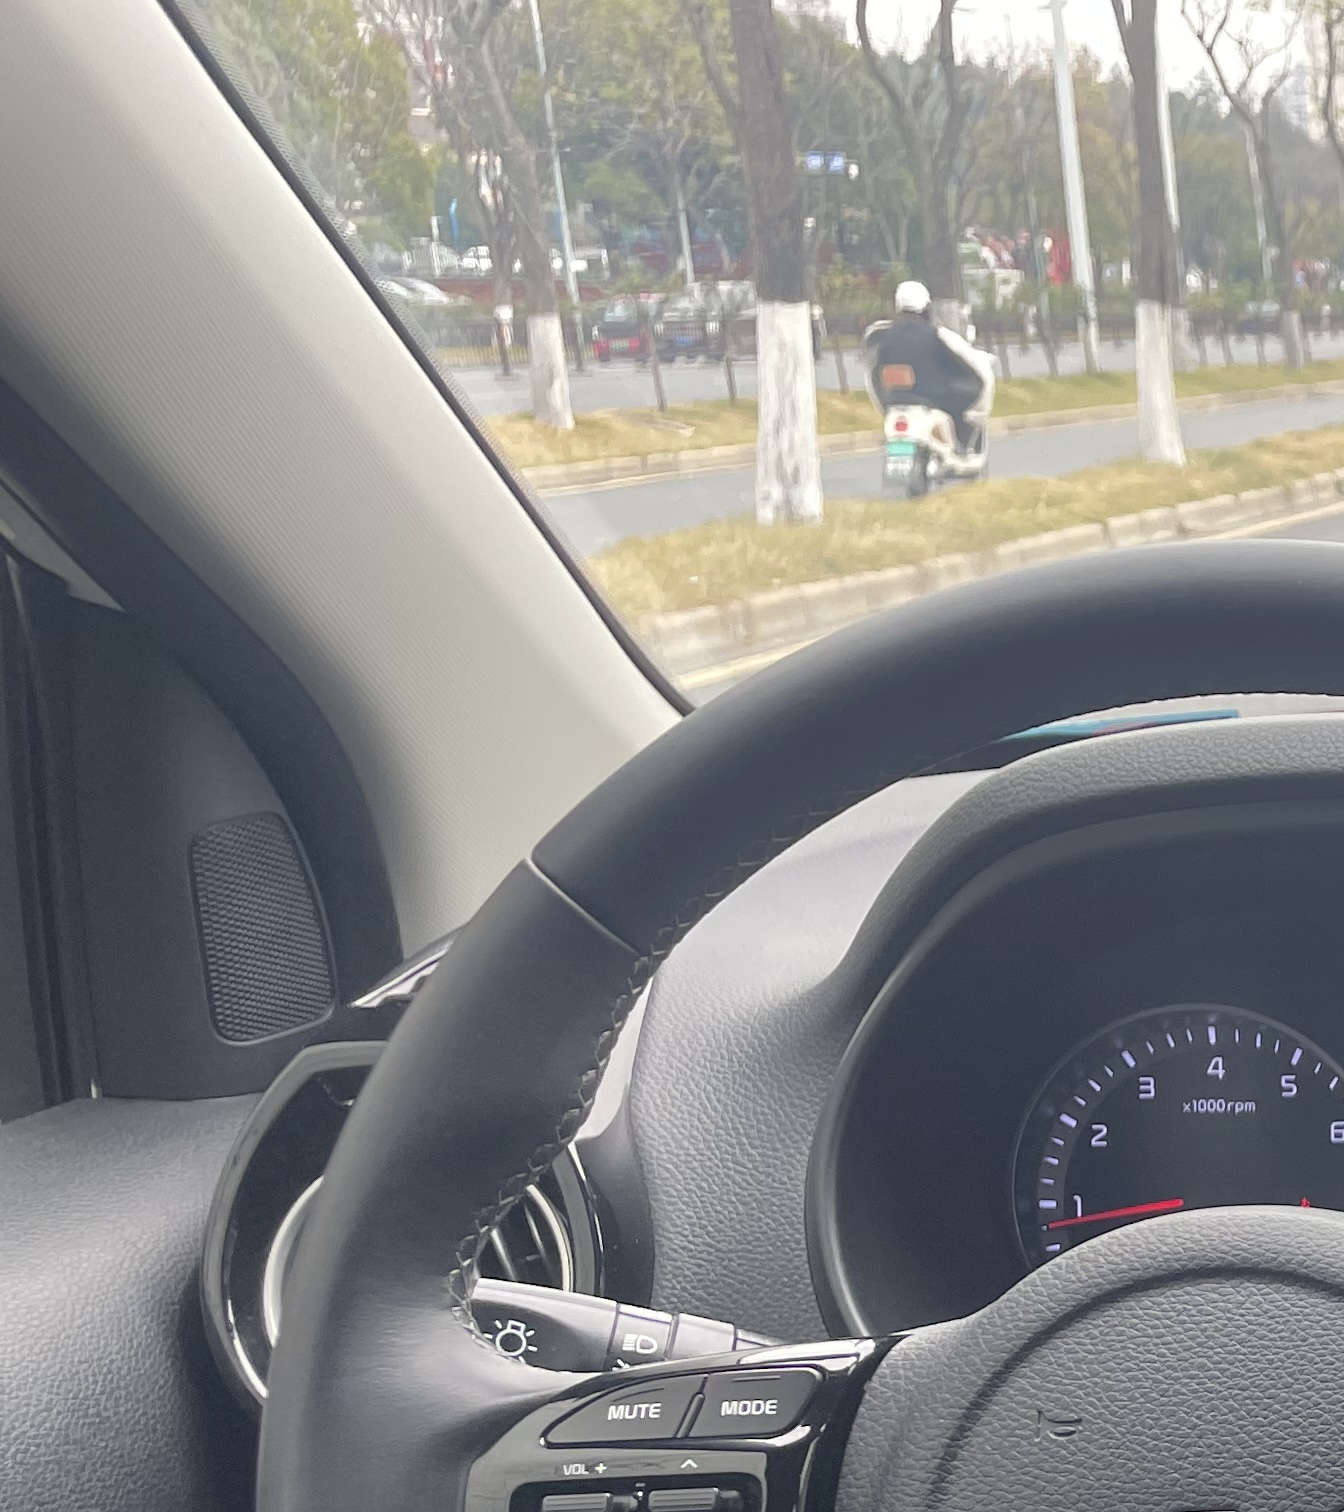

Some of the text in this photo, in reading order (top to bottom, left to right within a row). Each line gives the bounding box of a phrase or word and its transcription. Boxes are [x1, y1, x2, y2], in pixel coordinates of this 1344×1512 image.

[1206, 1056, 1226, 1080] 4
[1139, 1076, 1155, 1099] 3
[1281, 1075, 1298, 1097] 5
[1091, 1124, 1108, 1146] 2
[607, 1402, 662, 1421] MUTE
[720, 1399, 778, 1416] MODE
